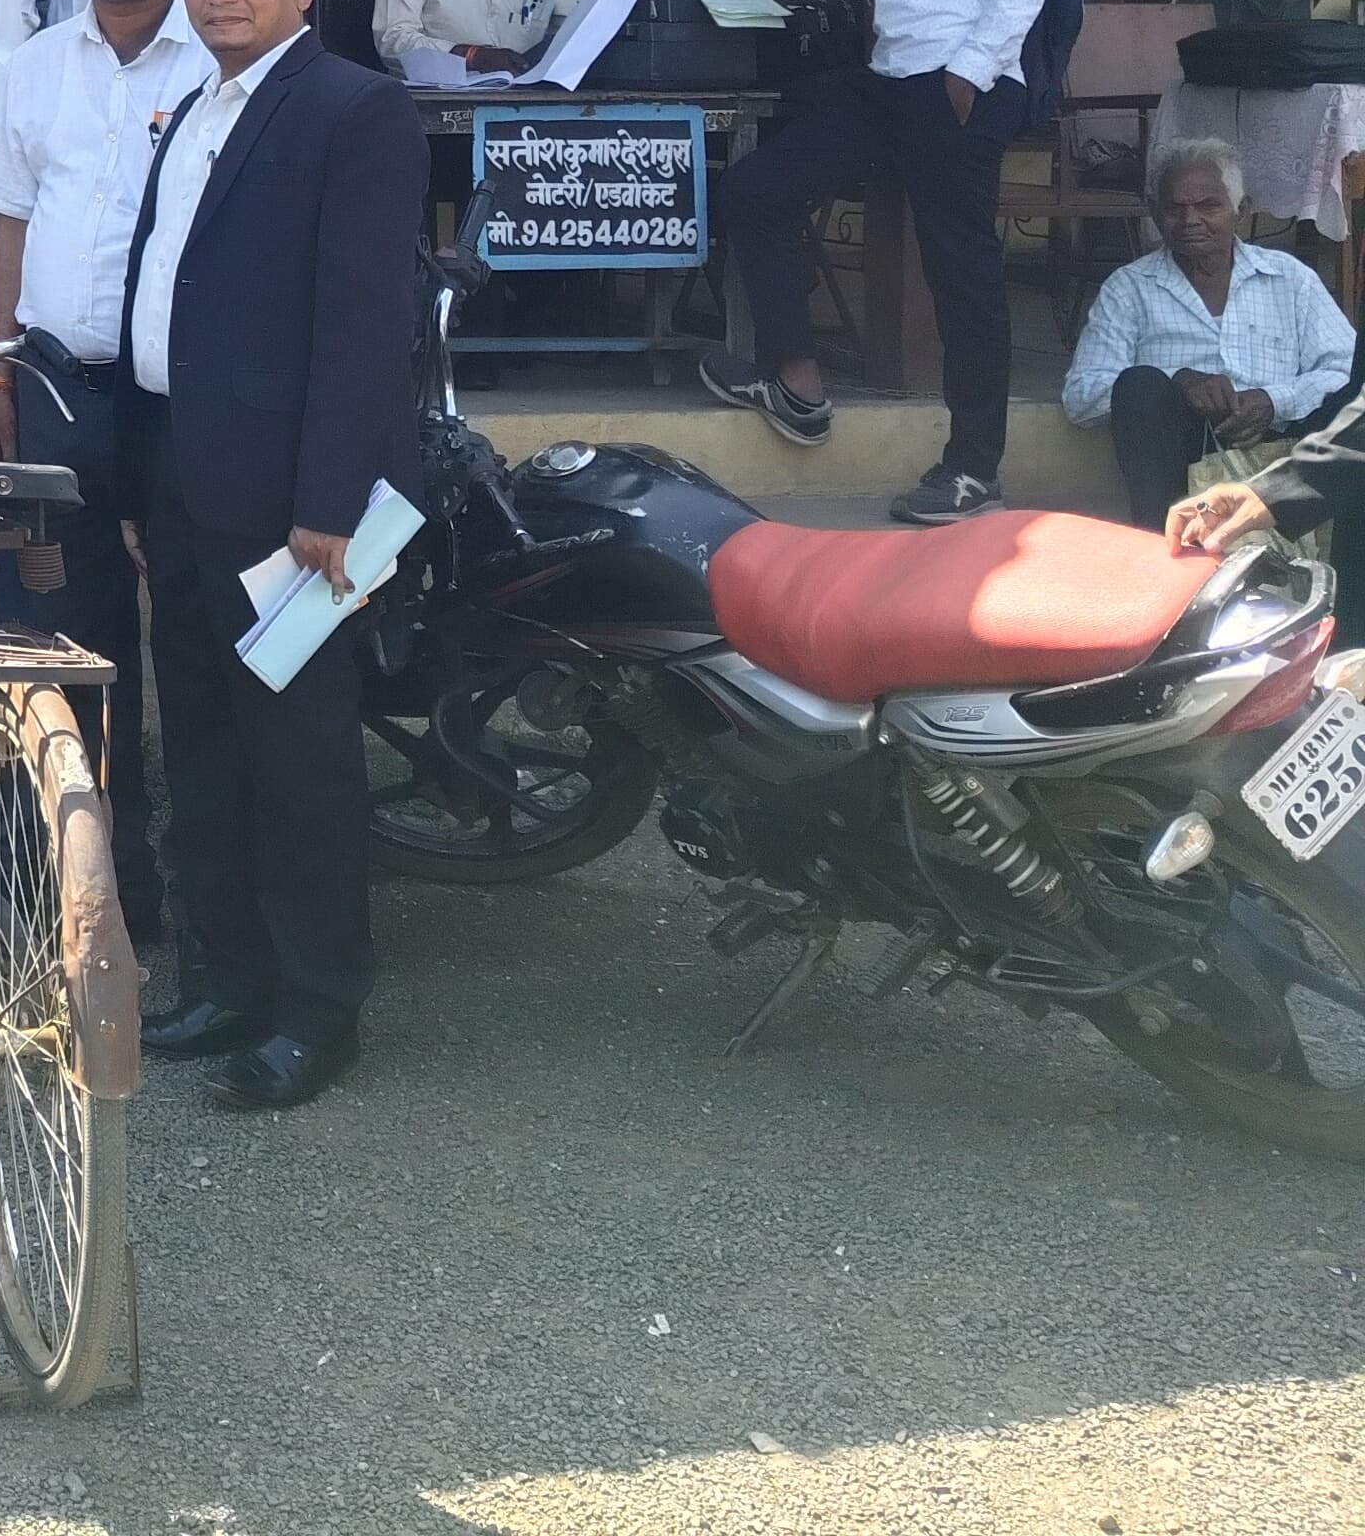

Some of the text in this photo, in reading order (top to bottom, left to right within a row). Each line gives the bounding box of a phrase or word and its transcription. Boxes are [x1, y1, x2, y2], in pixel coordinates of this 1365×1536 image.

[485, 125, 693, 178] सतीश कुमार देशमुख
[943, 704, 990, 722] 125
[673, 839, 710, 860] TVS
